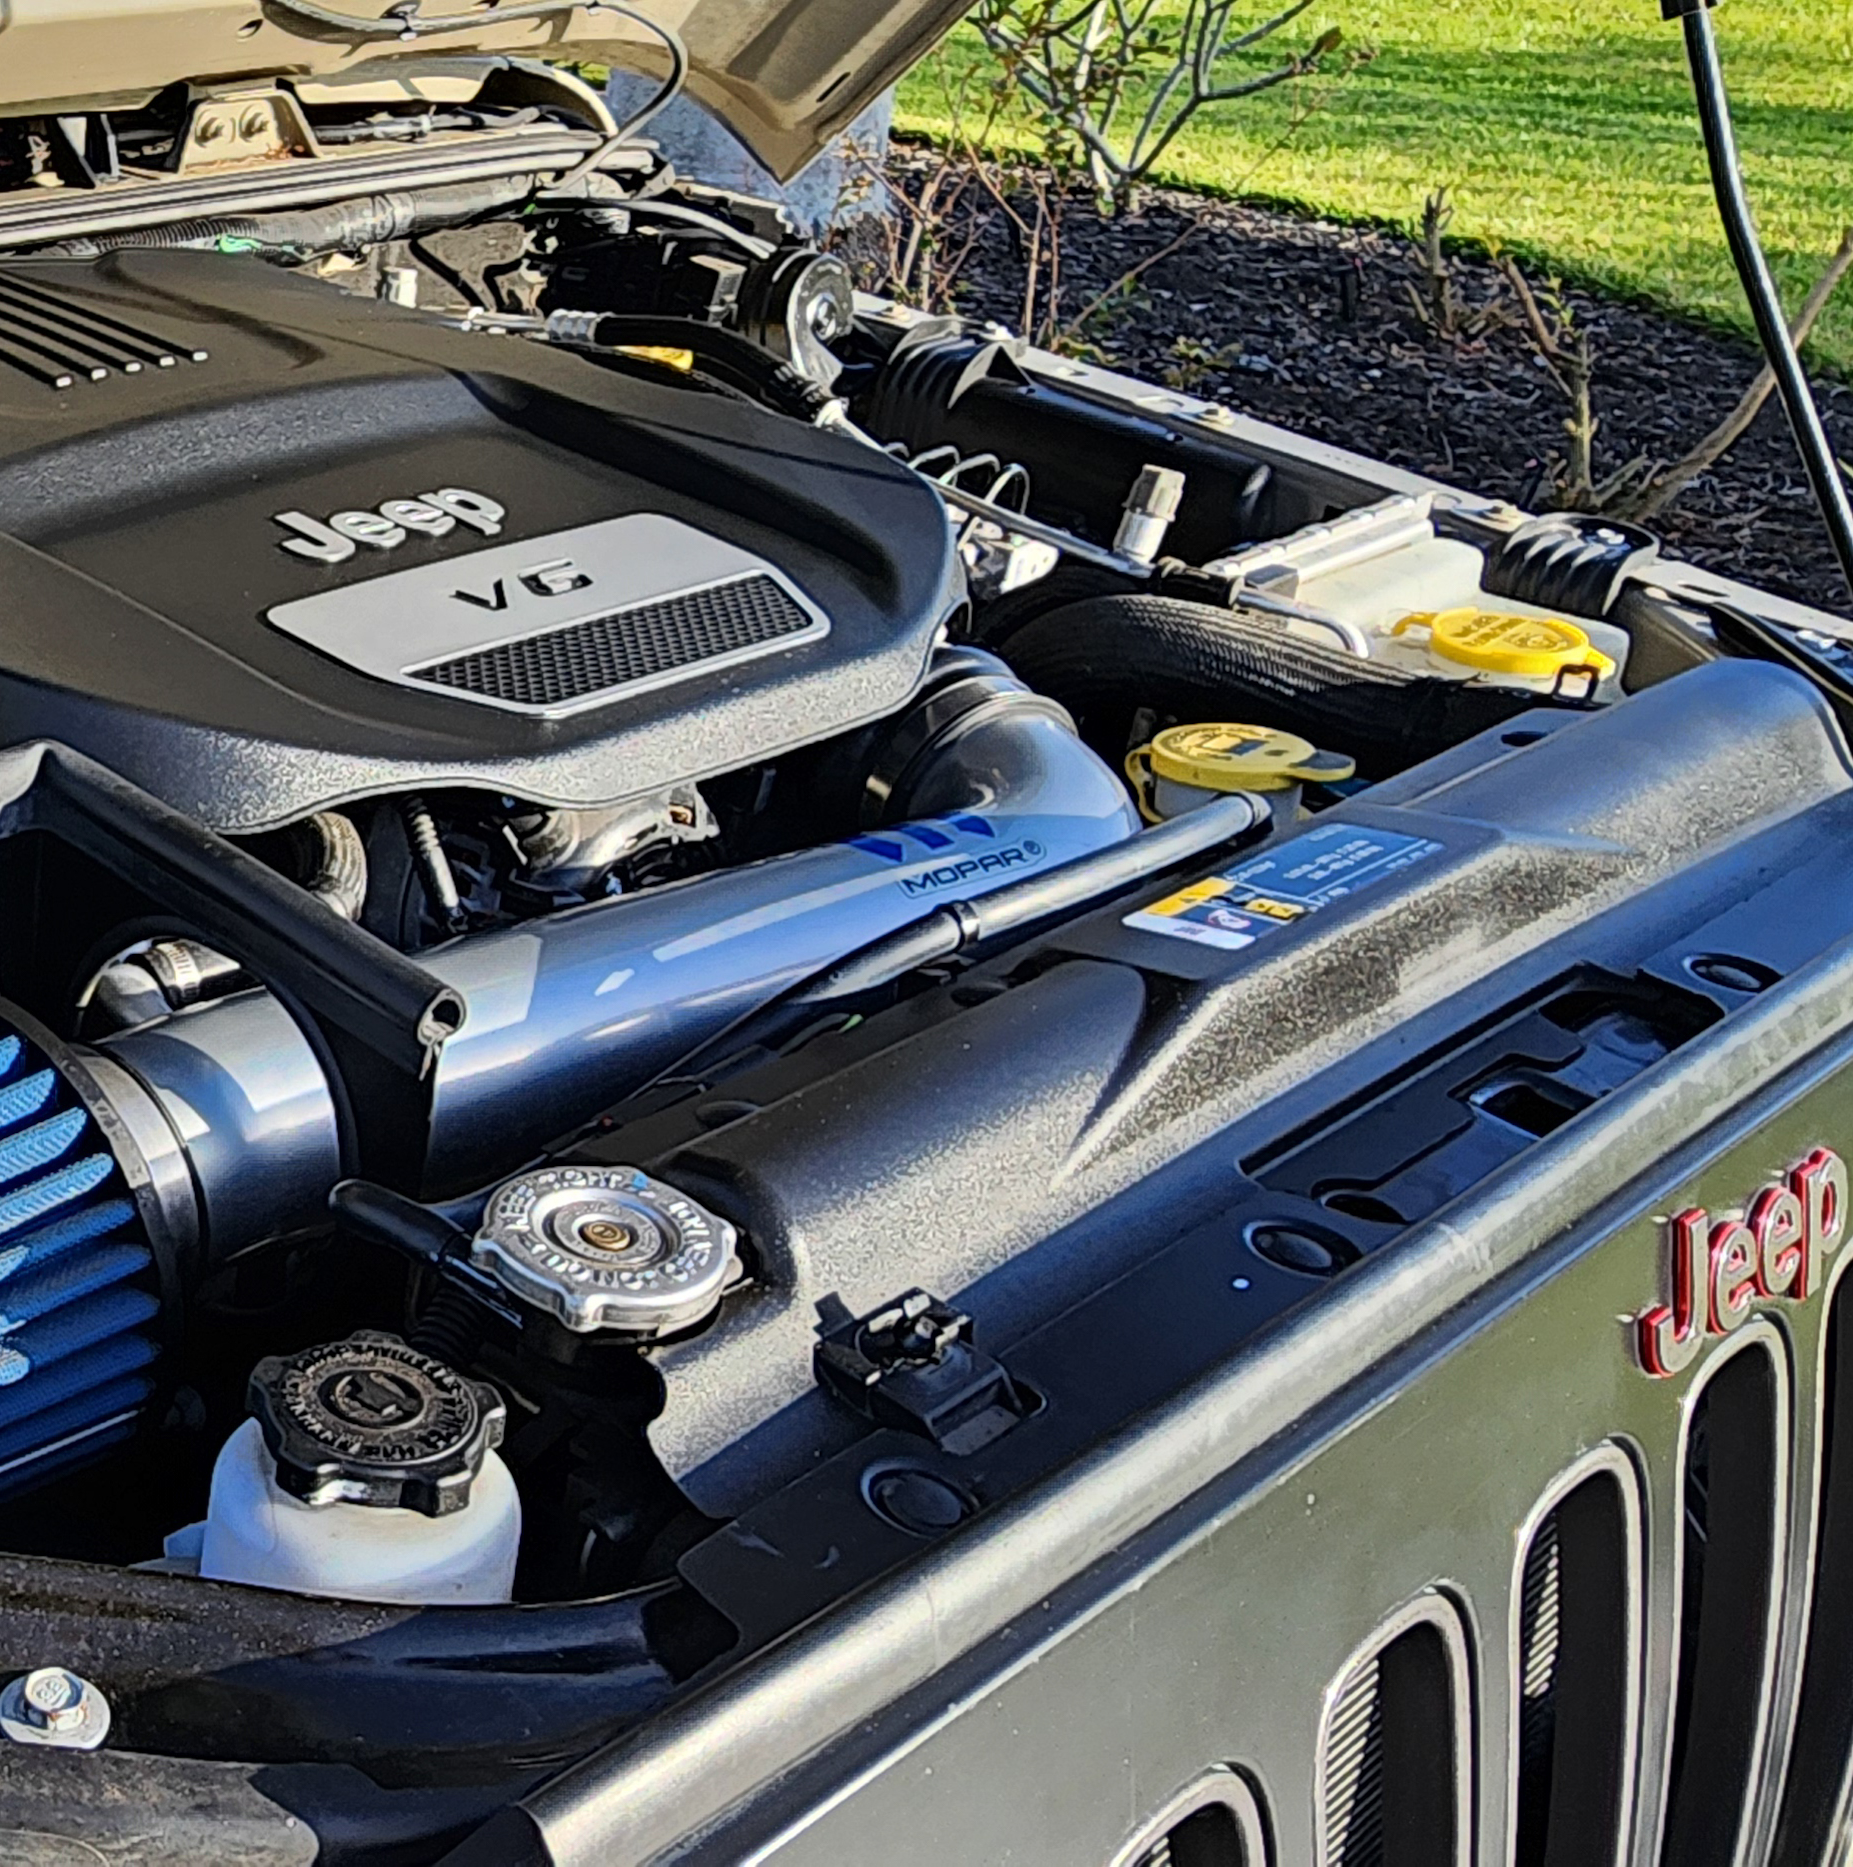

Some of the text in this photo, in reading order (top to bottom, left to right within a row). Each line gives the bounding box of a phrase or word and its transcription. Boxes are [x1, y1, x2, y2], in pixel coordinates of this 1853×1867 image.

[273, 487, 506, 563] Jeep
[449, 557, 595, 612] V6
[1634, 1145, 1849, 1379] Jeep
